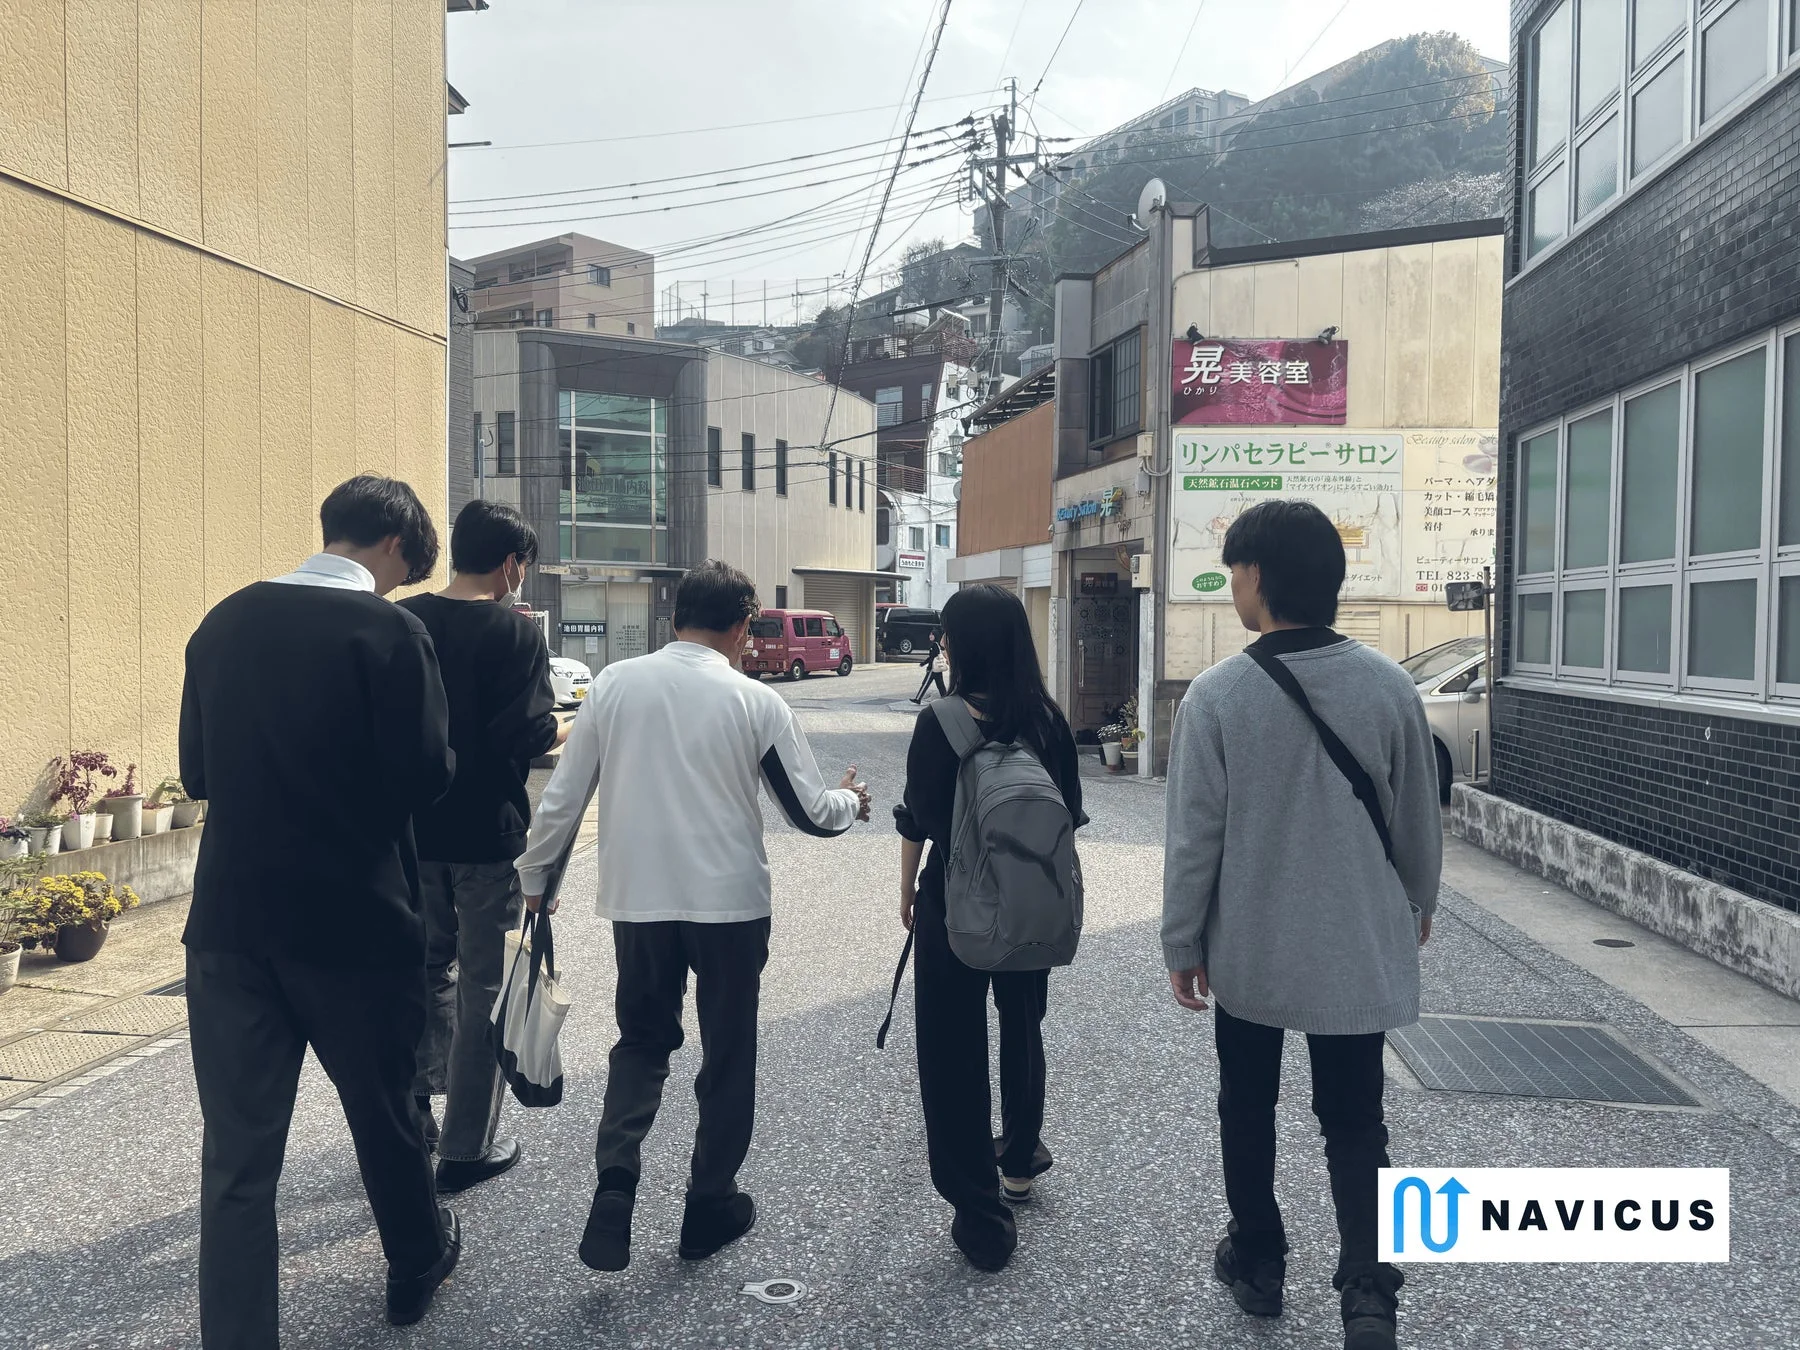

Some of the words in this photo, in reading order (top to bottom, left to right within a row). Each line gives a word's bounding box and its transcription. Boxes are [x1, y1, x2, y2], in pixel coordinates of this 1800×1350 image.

[1183, 386, 1218, 396] ひかり
[1406, 434, 1449, 448] Beauty
[1449, 434, 1476, 445] salon
[1424, 506, 1471, 517] 美顔コース
[1424, 521, 1442, 532] 着付
[1416, 570, 1443, 581] TEL
[563, 624, 604, 633] 池田胃腸内科
